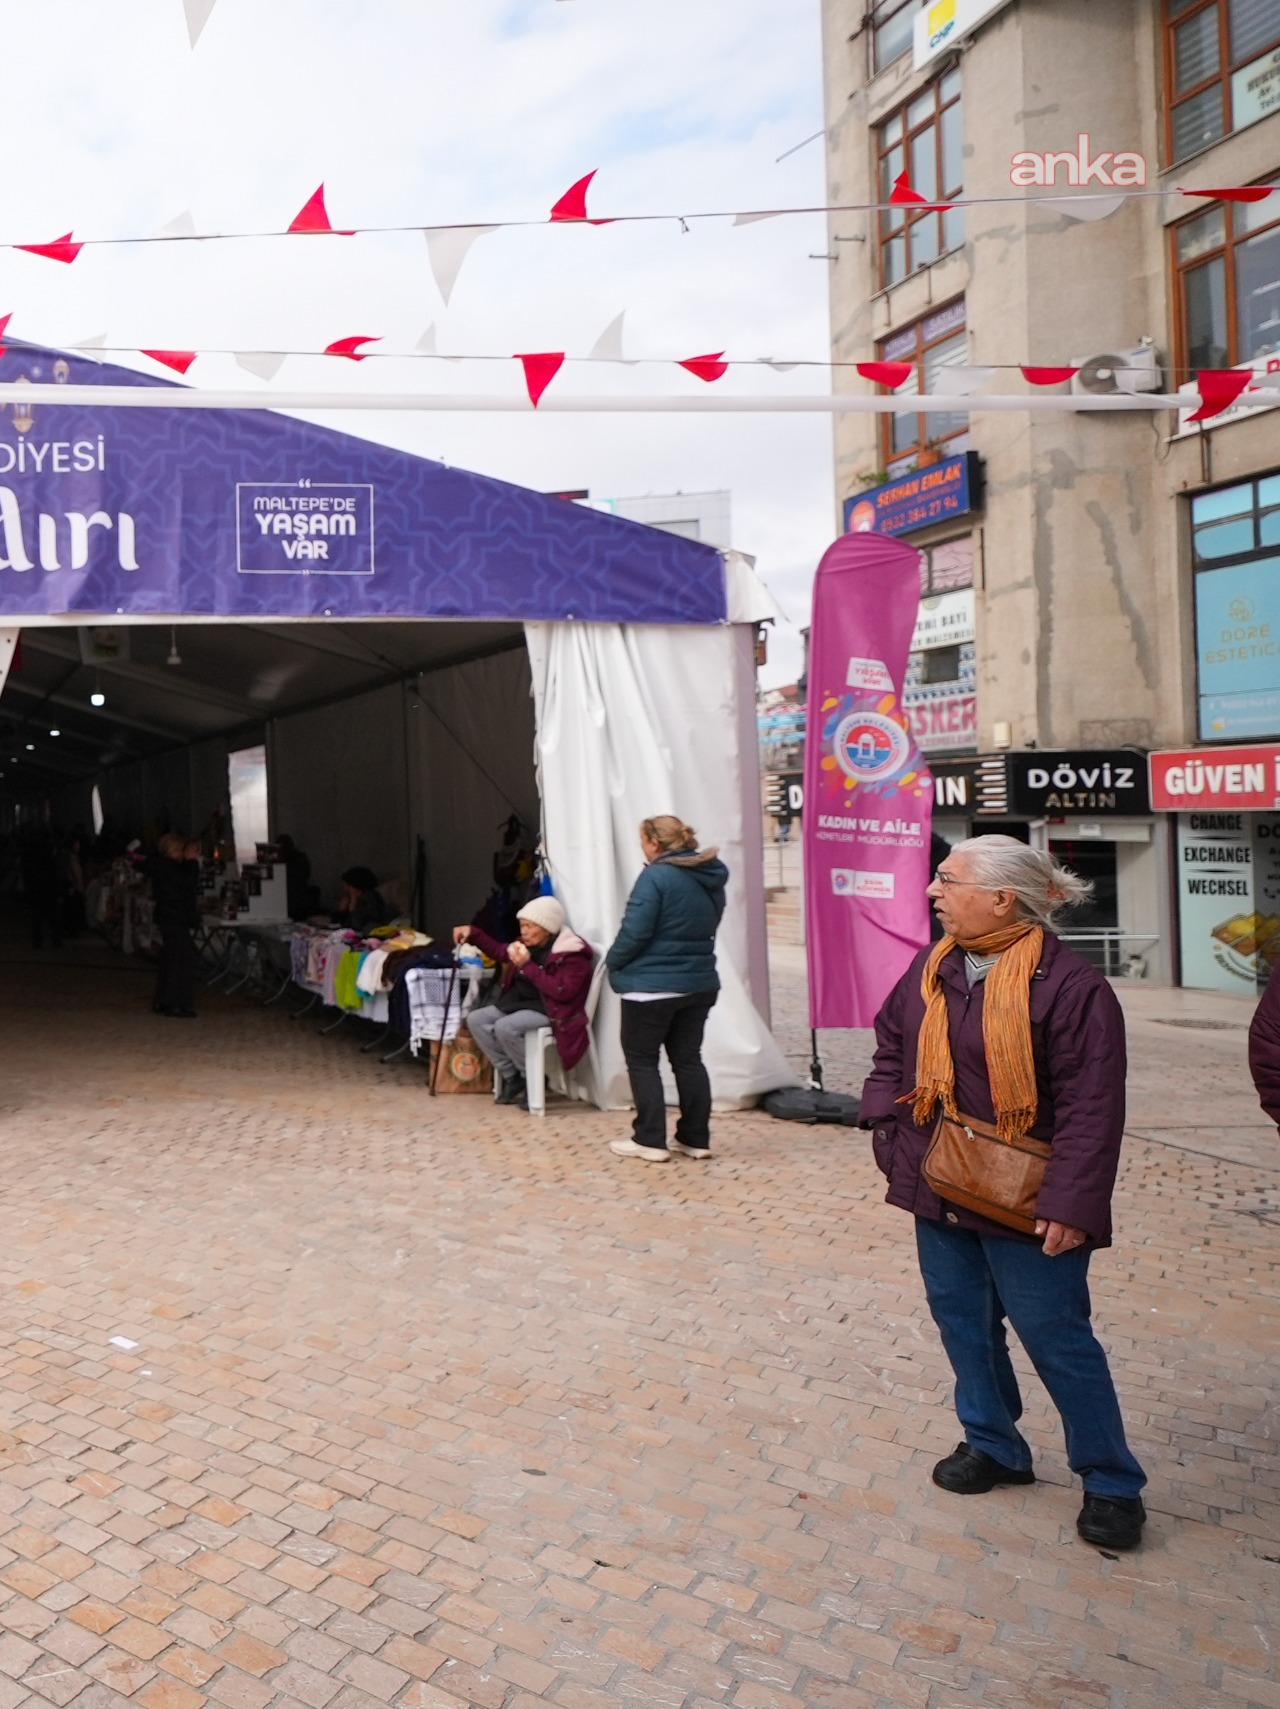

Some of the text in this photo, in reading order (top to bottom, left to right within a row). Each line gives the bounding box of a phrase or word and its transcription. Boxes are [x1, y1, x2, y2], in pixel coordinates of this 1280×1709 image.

[253, 496, 356, 512] MALTEPE'DE
[254, 512, 357, 541] YAŞAM
[281, 539, 329, 560] VAR
[1027, 762, 1135, 789] DÖVİZ
[1165, 759, 1265, 795] GÜVEN
[1045, 792, 1116, 808] ALTIN
[818, 814, 921, 836] KADIN VE AİLE
[1190, 814, 1243, 830] CHANGE
[1184, 846, 1251, 863] EXCHANGE
[1188, 879, 1249, 896] WECHSEL
